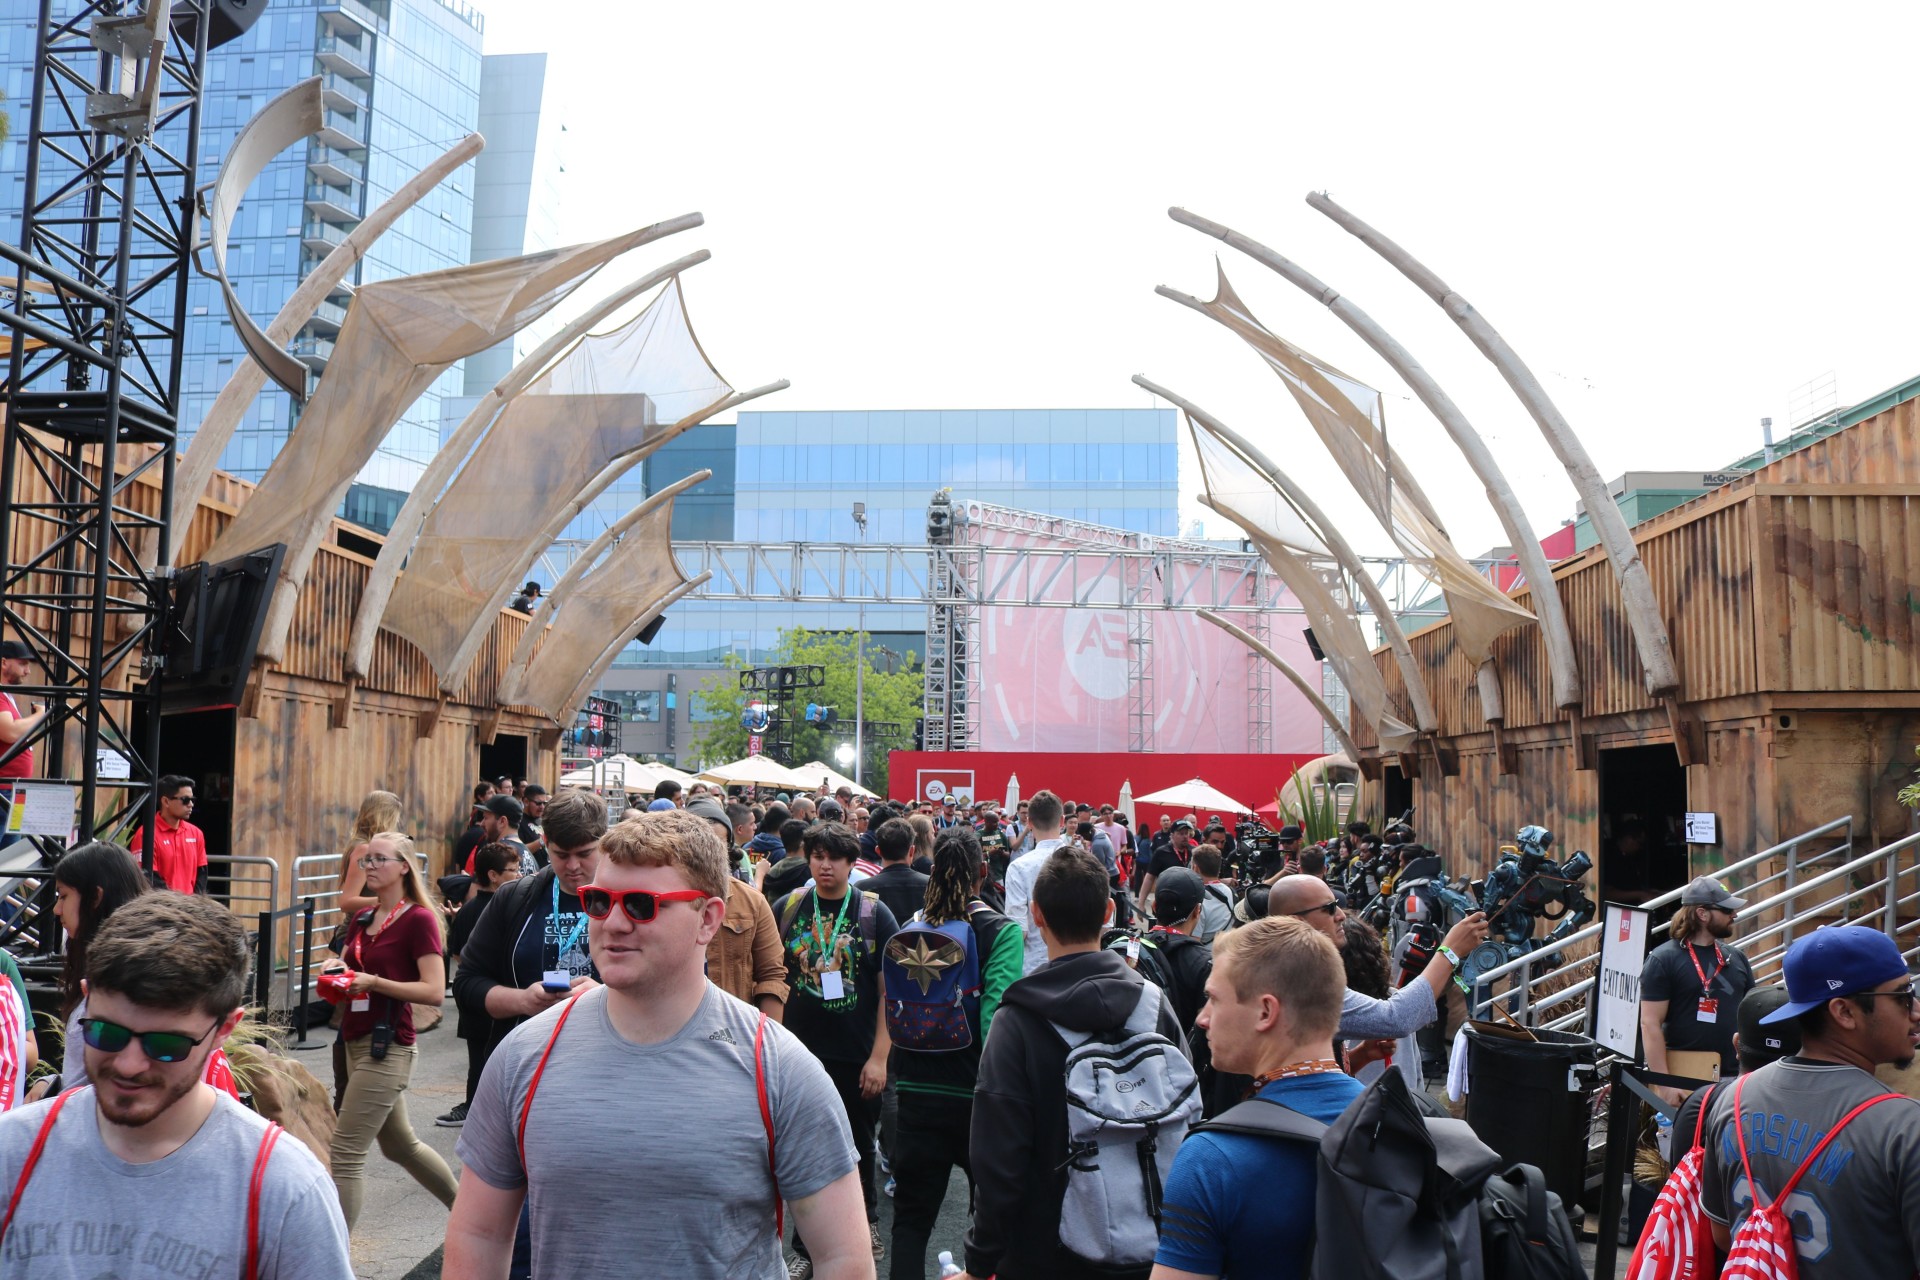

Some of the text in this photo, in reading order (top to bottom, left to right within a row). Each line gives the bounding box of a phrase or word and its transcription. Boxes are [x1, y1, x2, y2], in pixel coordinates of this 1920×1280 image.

[1703, 474, 1739, 482] McQu
[929, 786, 943, 794] EA
[545, 911, 576, 920] SAR
[1603, 967, 1640, 1004] EXIT ONLY
[709, 1034, 737, 1045] adidas
[1723, 1111, 1855, 1186] KERSHAW
[68, 1221, 140, 1260] DUCK
